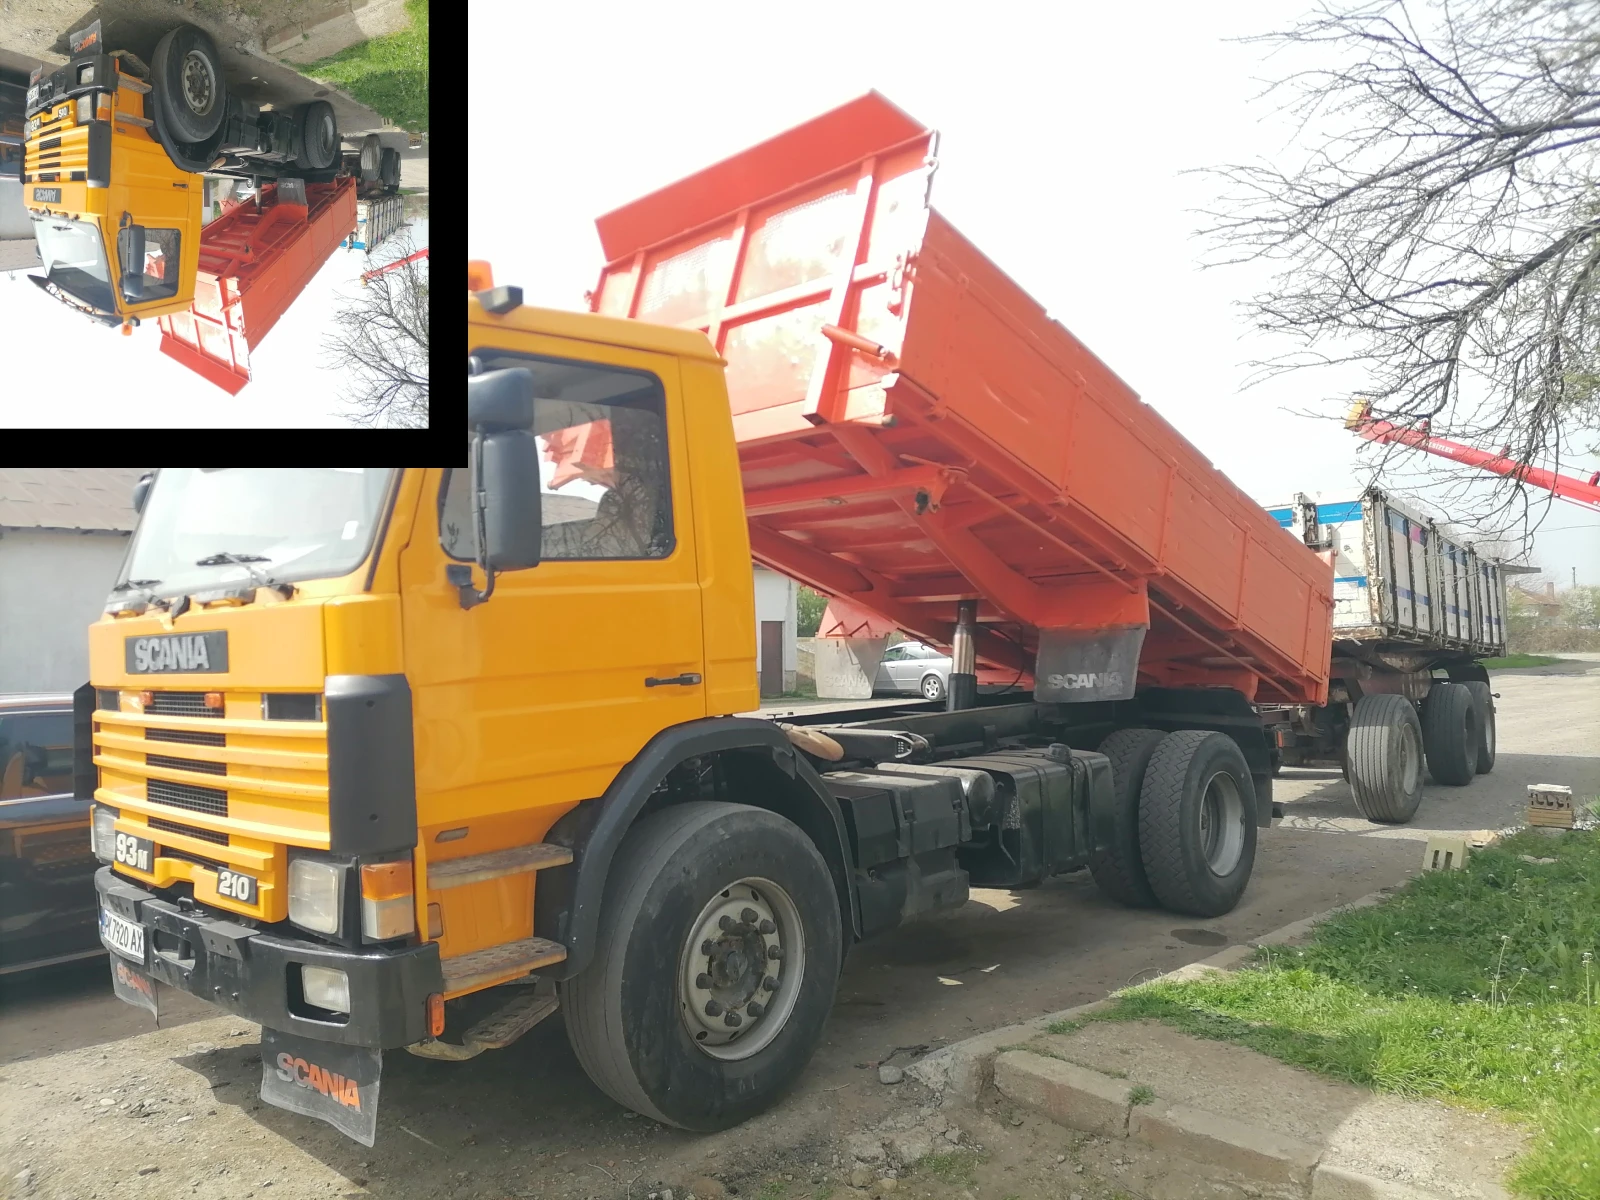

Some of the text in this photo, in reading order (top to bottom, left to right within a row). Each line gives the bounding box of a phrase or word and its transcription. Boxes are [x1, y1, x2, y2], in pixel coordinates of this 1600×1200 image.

[134, 634, 211, 672] SCANIA
[1047, 672, 1124, 690] SCANIA
[218, 871, 250, 901] 210
[276, 1052, 362, 1113] SCANIA
